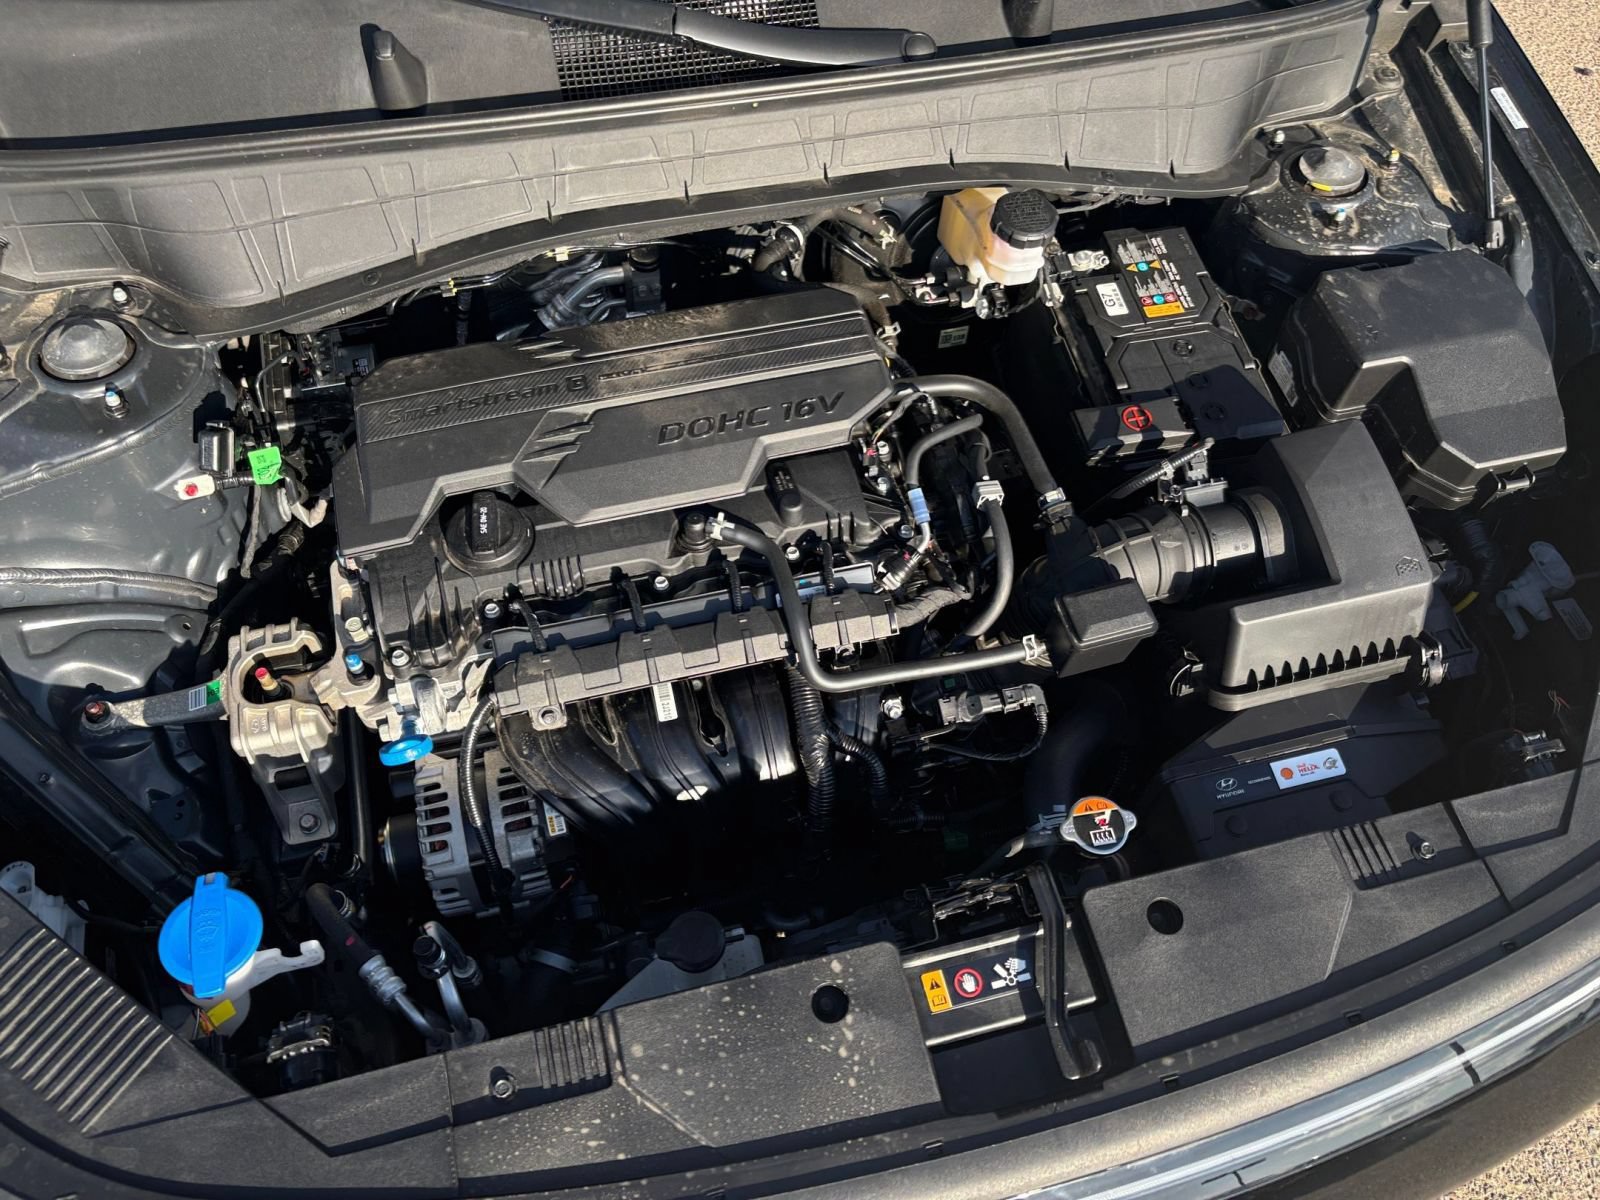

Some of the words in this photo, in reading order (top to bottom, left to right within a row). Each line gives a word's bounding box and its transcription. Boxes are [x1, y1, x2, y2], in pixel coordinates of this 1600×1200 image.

[1101, 293, 1116, 307] G7
[385, 382, 559, 425] Smartstream
[657, 406, 772, 446] DOHC
[782, 391, 845, 422] 16V
[480, 523, 488, 534] SAE
[1216, 788, 1245, 799] HYUNDAI
